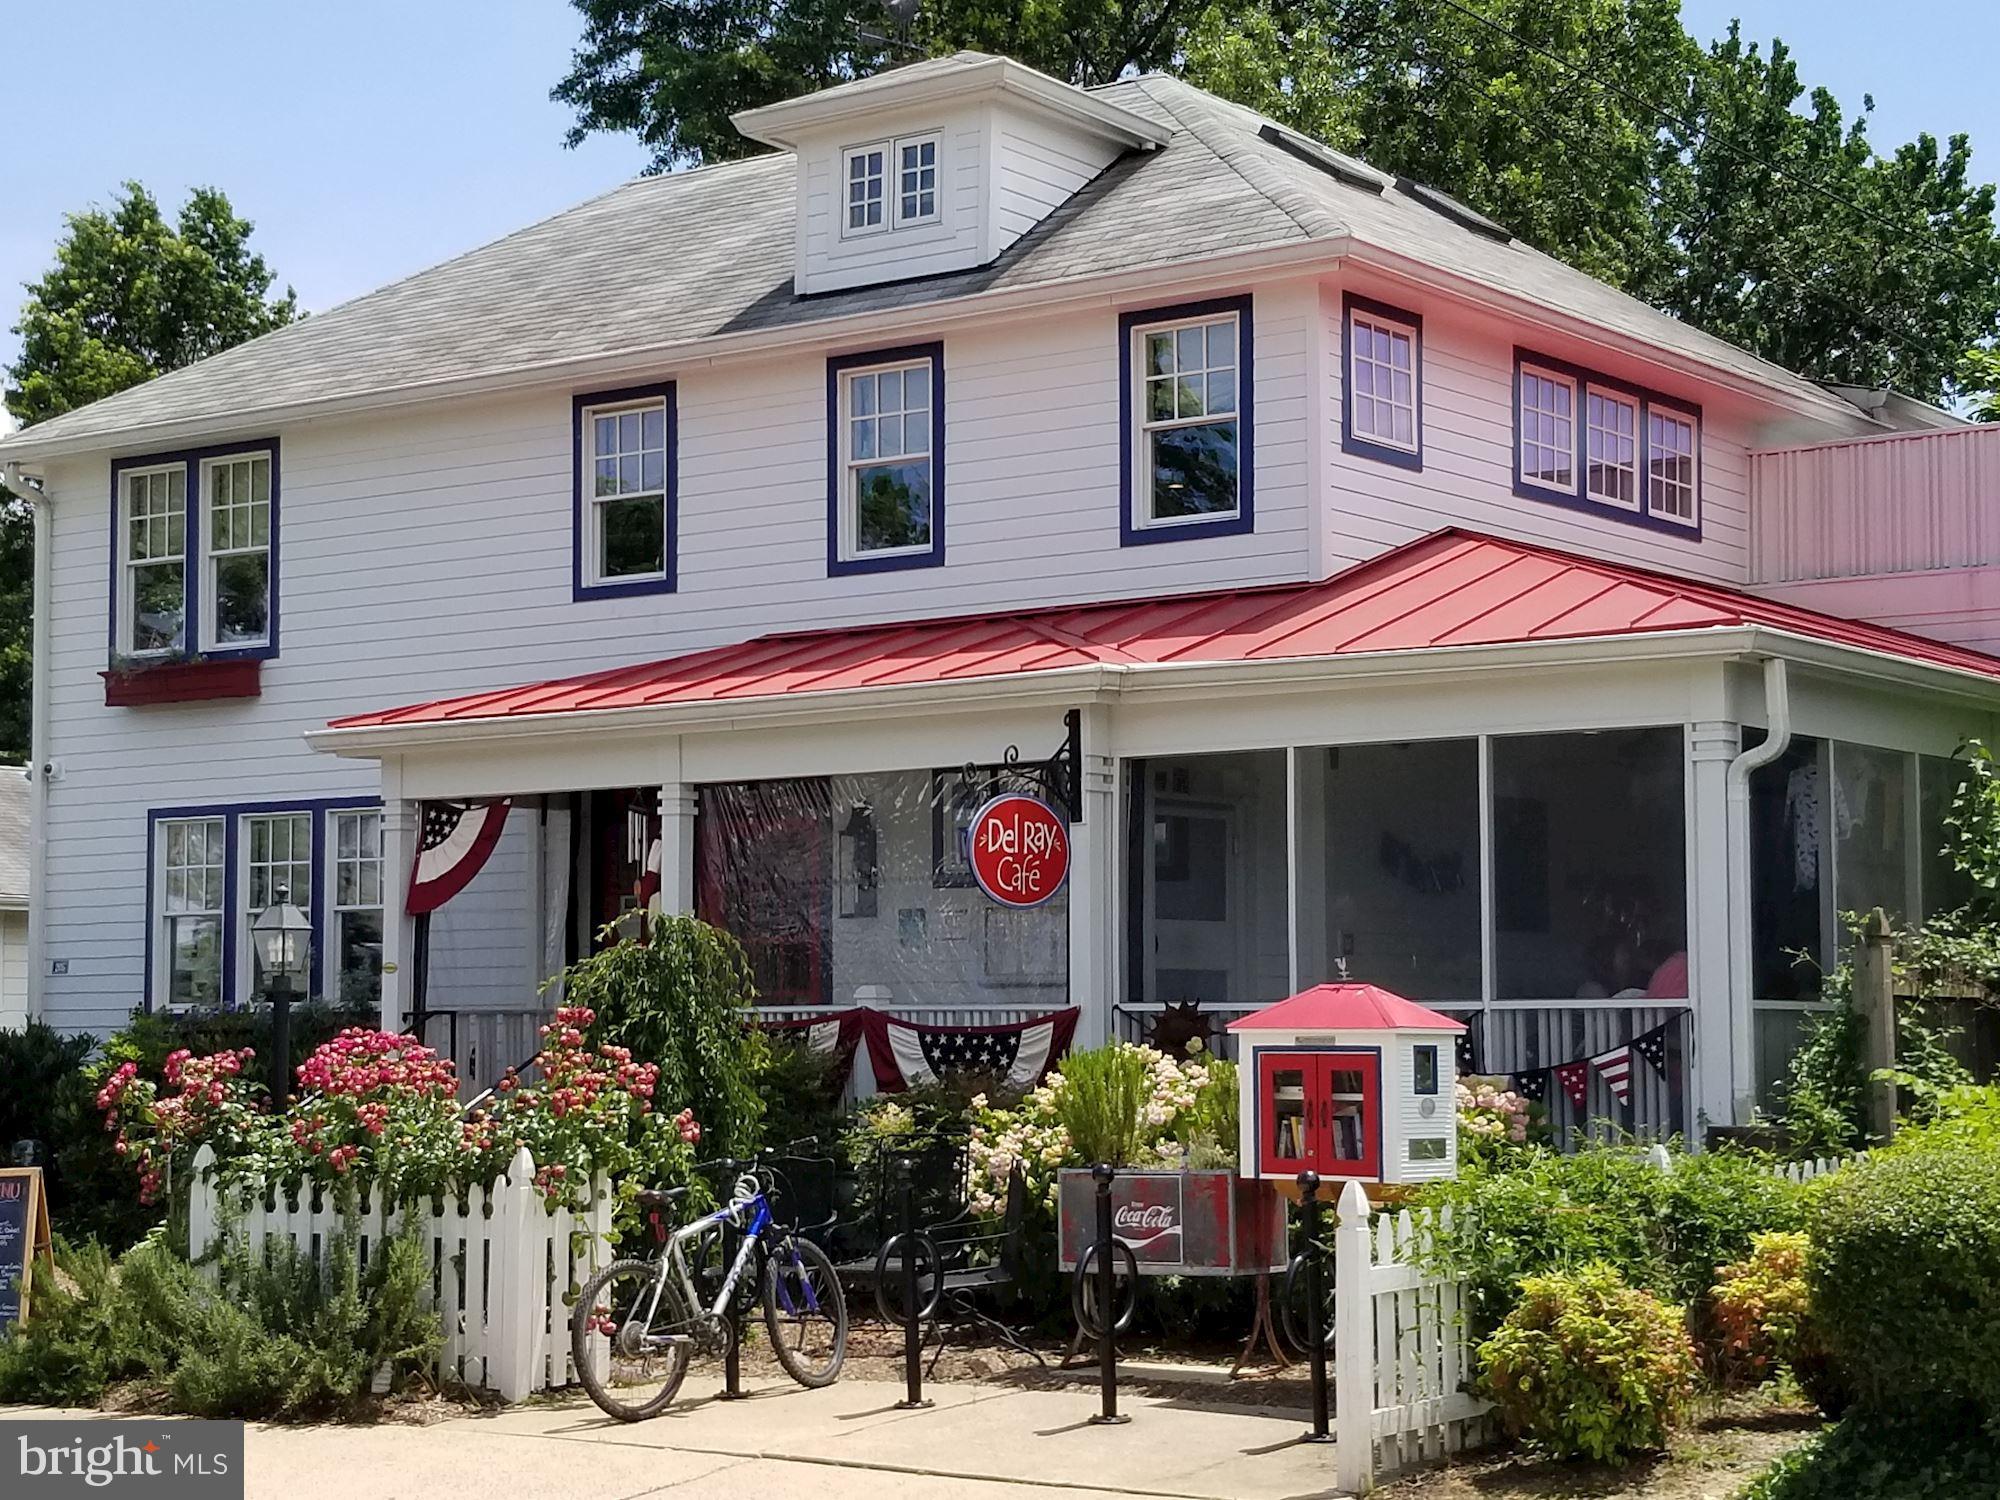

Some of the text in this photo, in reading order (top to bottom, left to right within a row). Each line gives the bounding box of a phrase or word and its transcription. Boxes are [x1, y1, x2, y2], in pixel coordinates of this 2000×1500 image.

[987, 813, 1058, 860] Del Ray
[997, 854, 1041, 896] Café
[0, 1182, 20, 1200] NU
[1114, 1205, 1175, 1228] Coca-Cola
